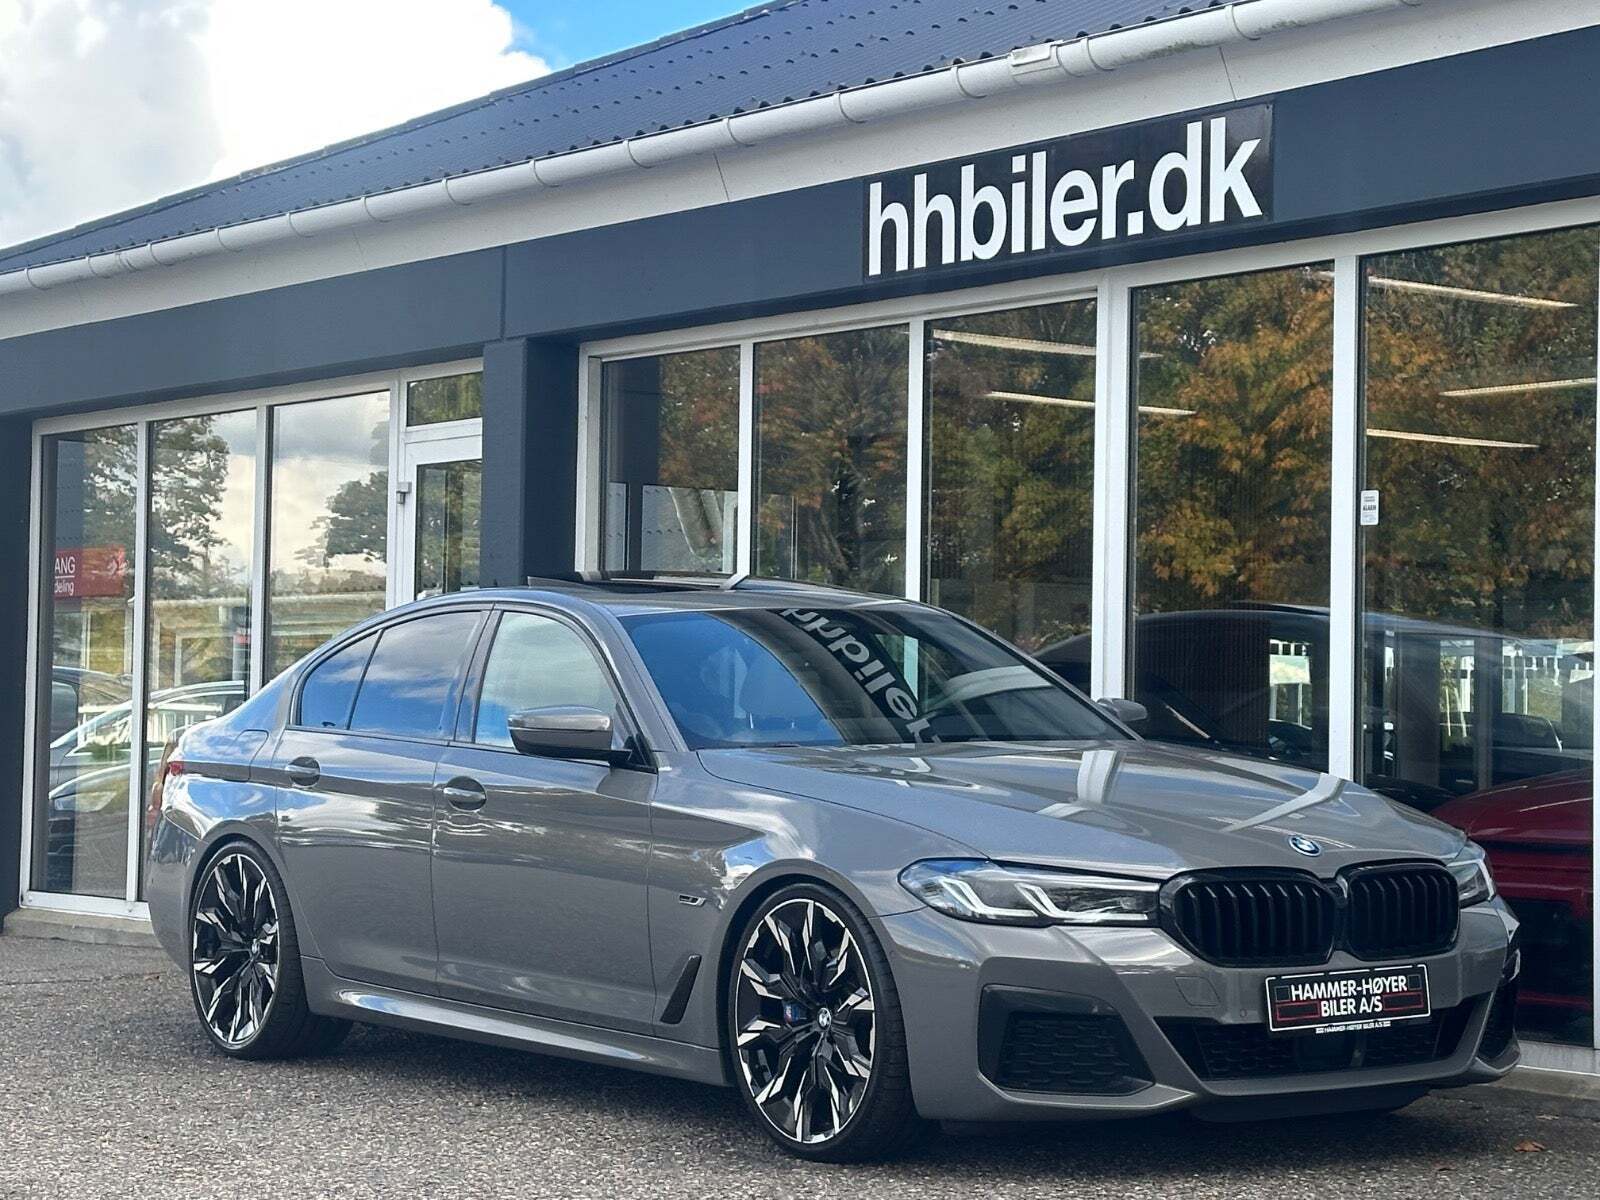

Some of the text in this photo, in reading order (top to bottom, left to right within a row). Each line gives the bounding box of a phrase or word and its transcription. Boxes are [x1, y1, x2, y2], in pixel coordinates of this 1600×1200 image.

[868, 116, 1263, 277] hhbiler.dk
[54, 556, 76, 574] ANG
[1291, 975, 1408, 1002] HAMMER-HØYER
[1320, 995, 1383, 1018] BILER A/S
